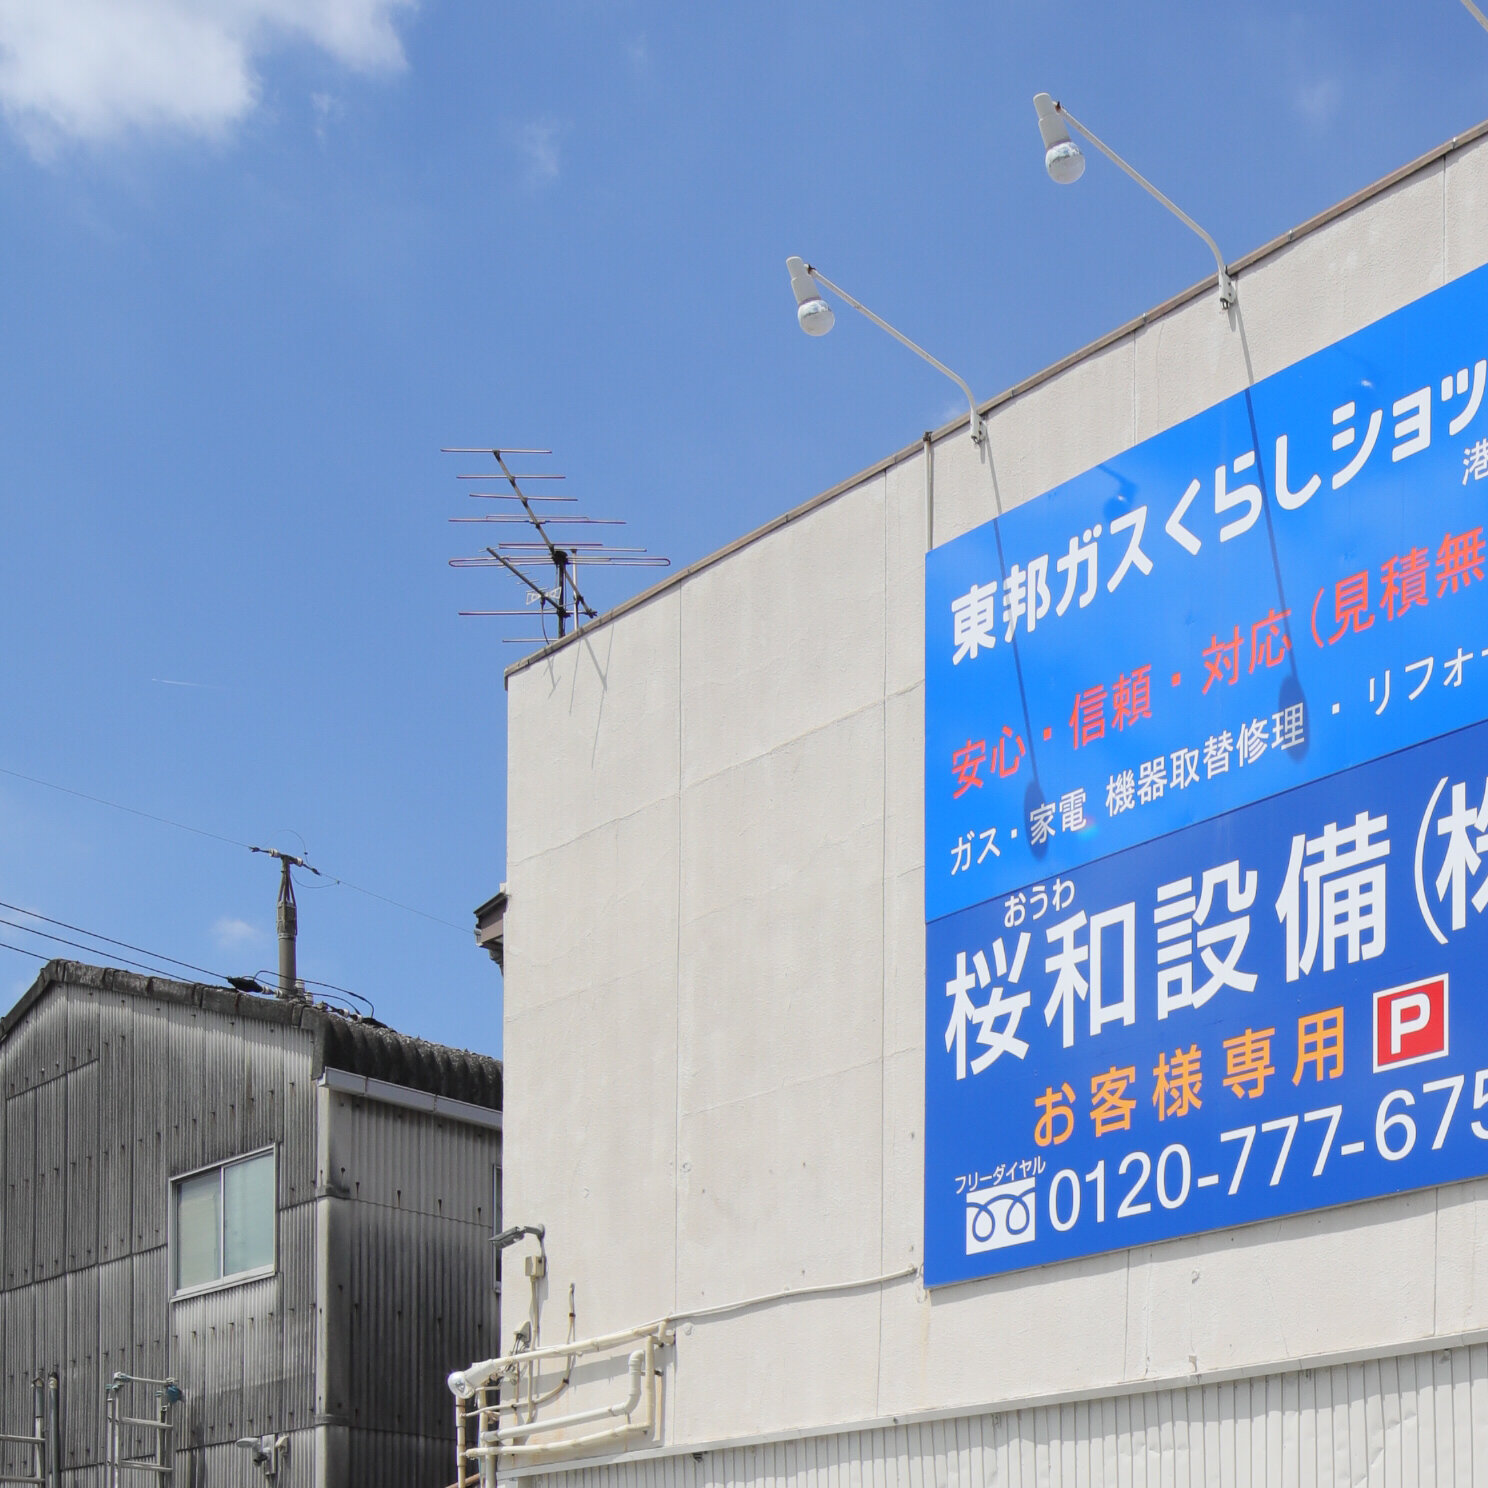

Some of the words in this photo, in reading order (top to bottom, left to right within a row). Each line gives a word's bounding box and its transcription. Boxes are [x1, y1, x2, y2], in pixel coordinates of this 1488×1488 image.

[1003, 878, 1076, 927] おうわ
[1390, 992, 1431, 1054] P
[1033, 1007, 1344, 1148] お客様専用
[955, 1156, 1046, 1196] フリーダイヤル
